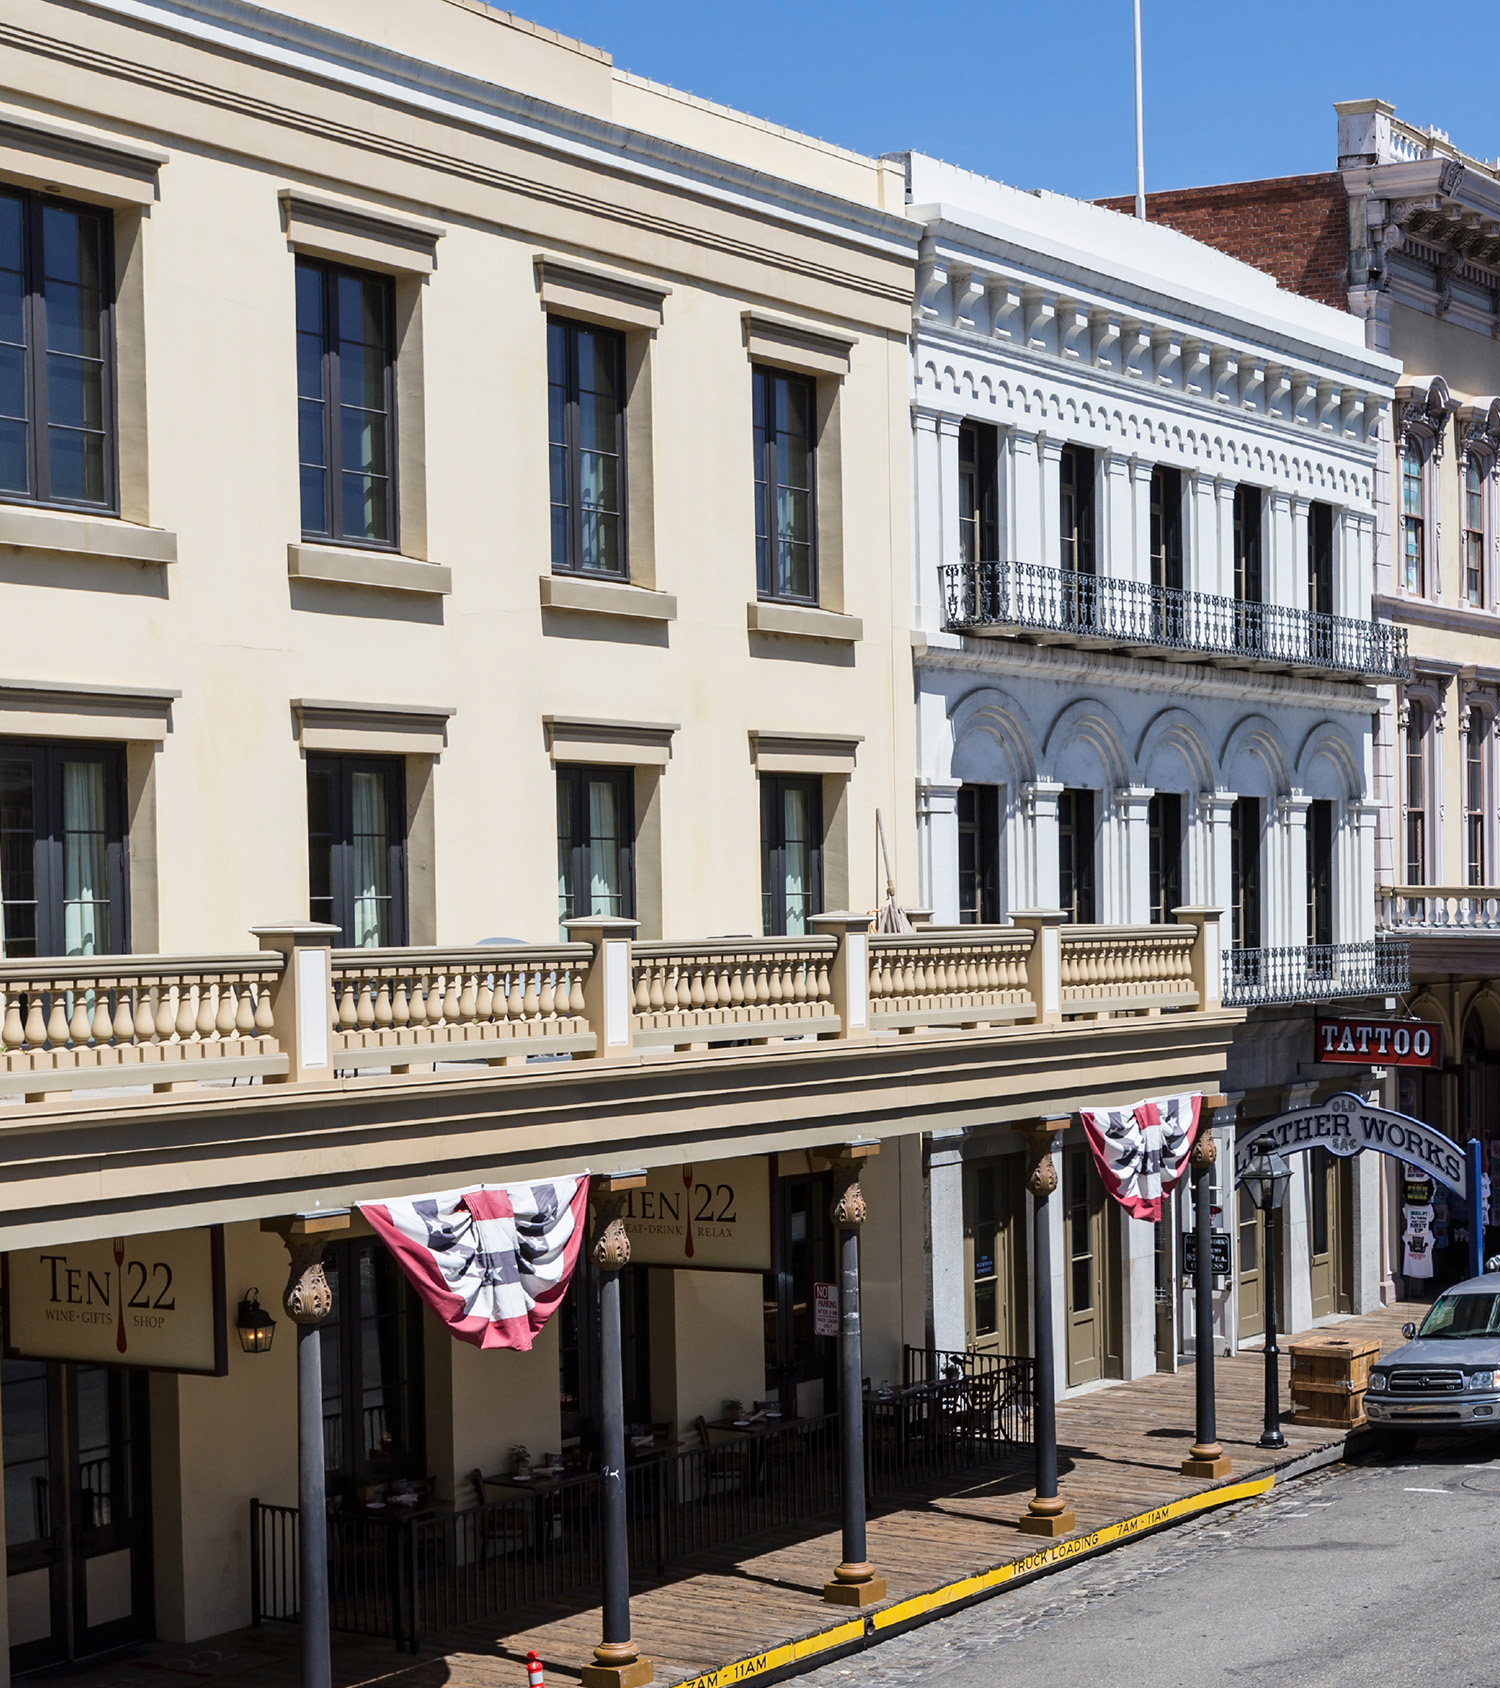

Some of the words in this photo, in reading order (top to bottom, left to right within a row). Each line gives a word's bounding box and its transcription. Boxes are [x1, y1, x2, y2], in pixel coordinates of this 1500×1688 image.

[1322, 1025, 1431, 1056] TATTOO
[1332, 1101, 1357, 1113] OLD
[1332, 1138, 1357, 1150] SAC
[1360, 1115, 1461, 1183] WORKS
[694, 1183, 737, 1223] 22
[649, 1224, 683, 1236] DRINK
[698, 1227, 733, 1238] RELAX
[40, 1255, 111, 1306] TEN
[127, 1261, 175, 1310] 22
[816, 1285, 828, 1298] NO
[45, 1309, 75, 1322] WINE
[81, 1310, 112, 1325] GIFTS
[133, 1315, 165, 1329] SHOP
[1012, 1552, 1048, 1576] TRUCK
[1052, 1534, 1099, 1561] LOADING
[1116, 1520, 1138, 1536] 7AM
[1147, 1508, 1170, 1524] 11AM
[734, 1656, 767, 1679] 11AM
